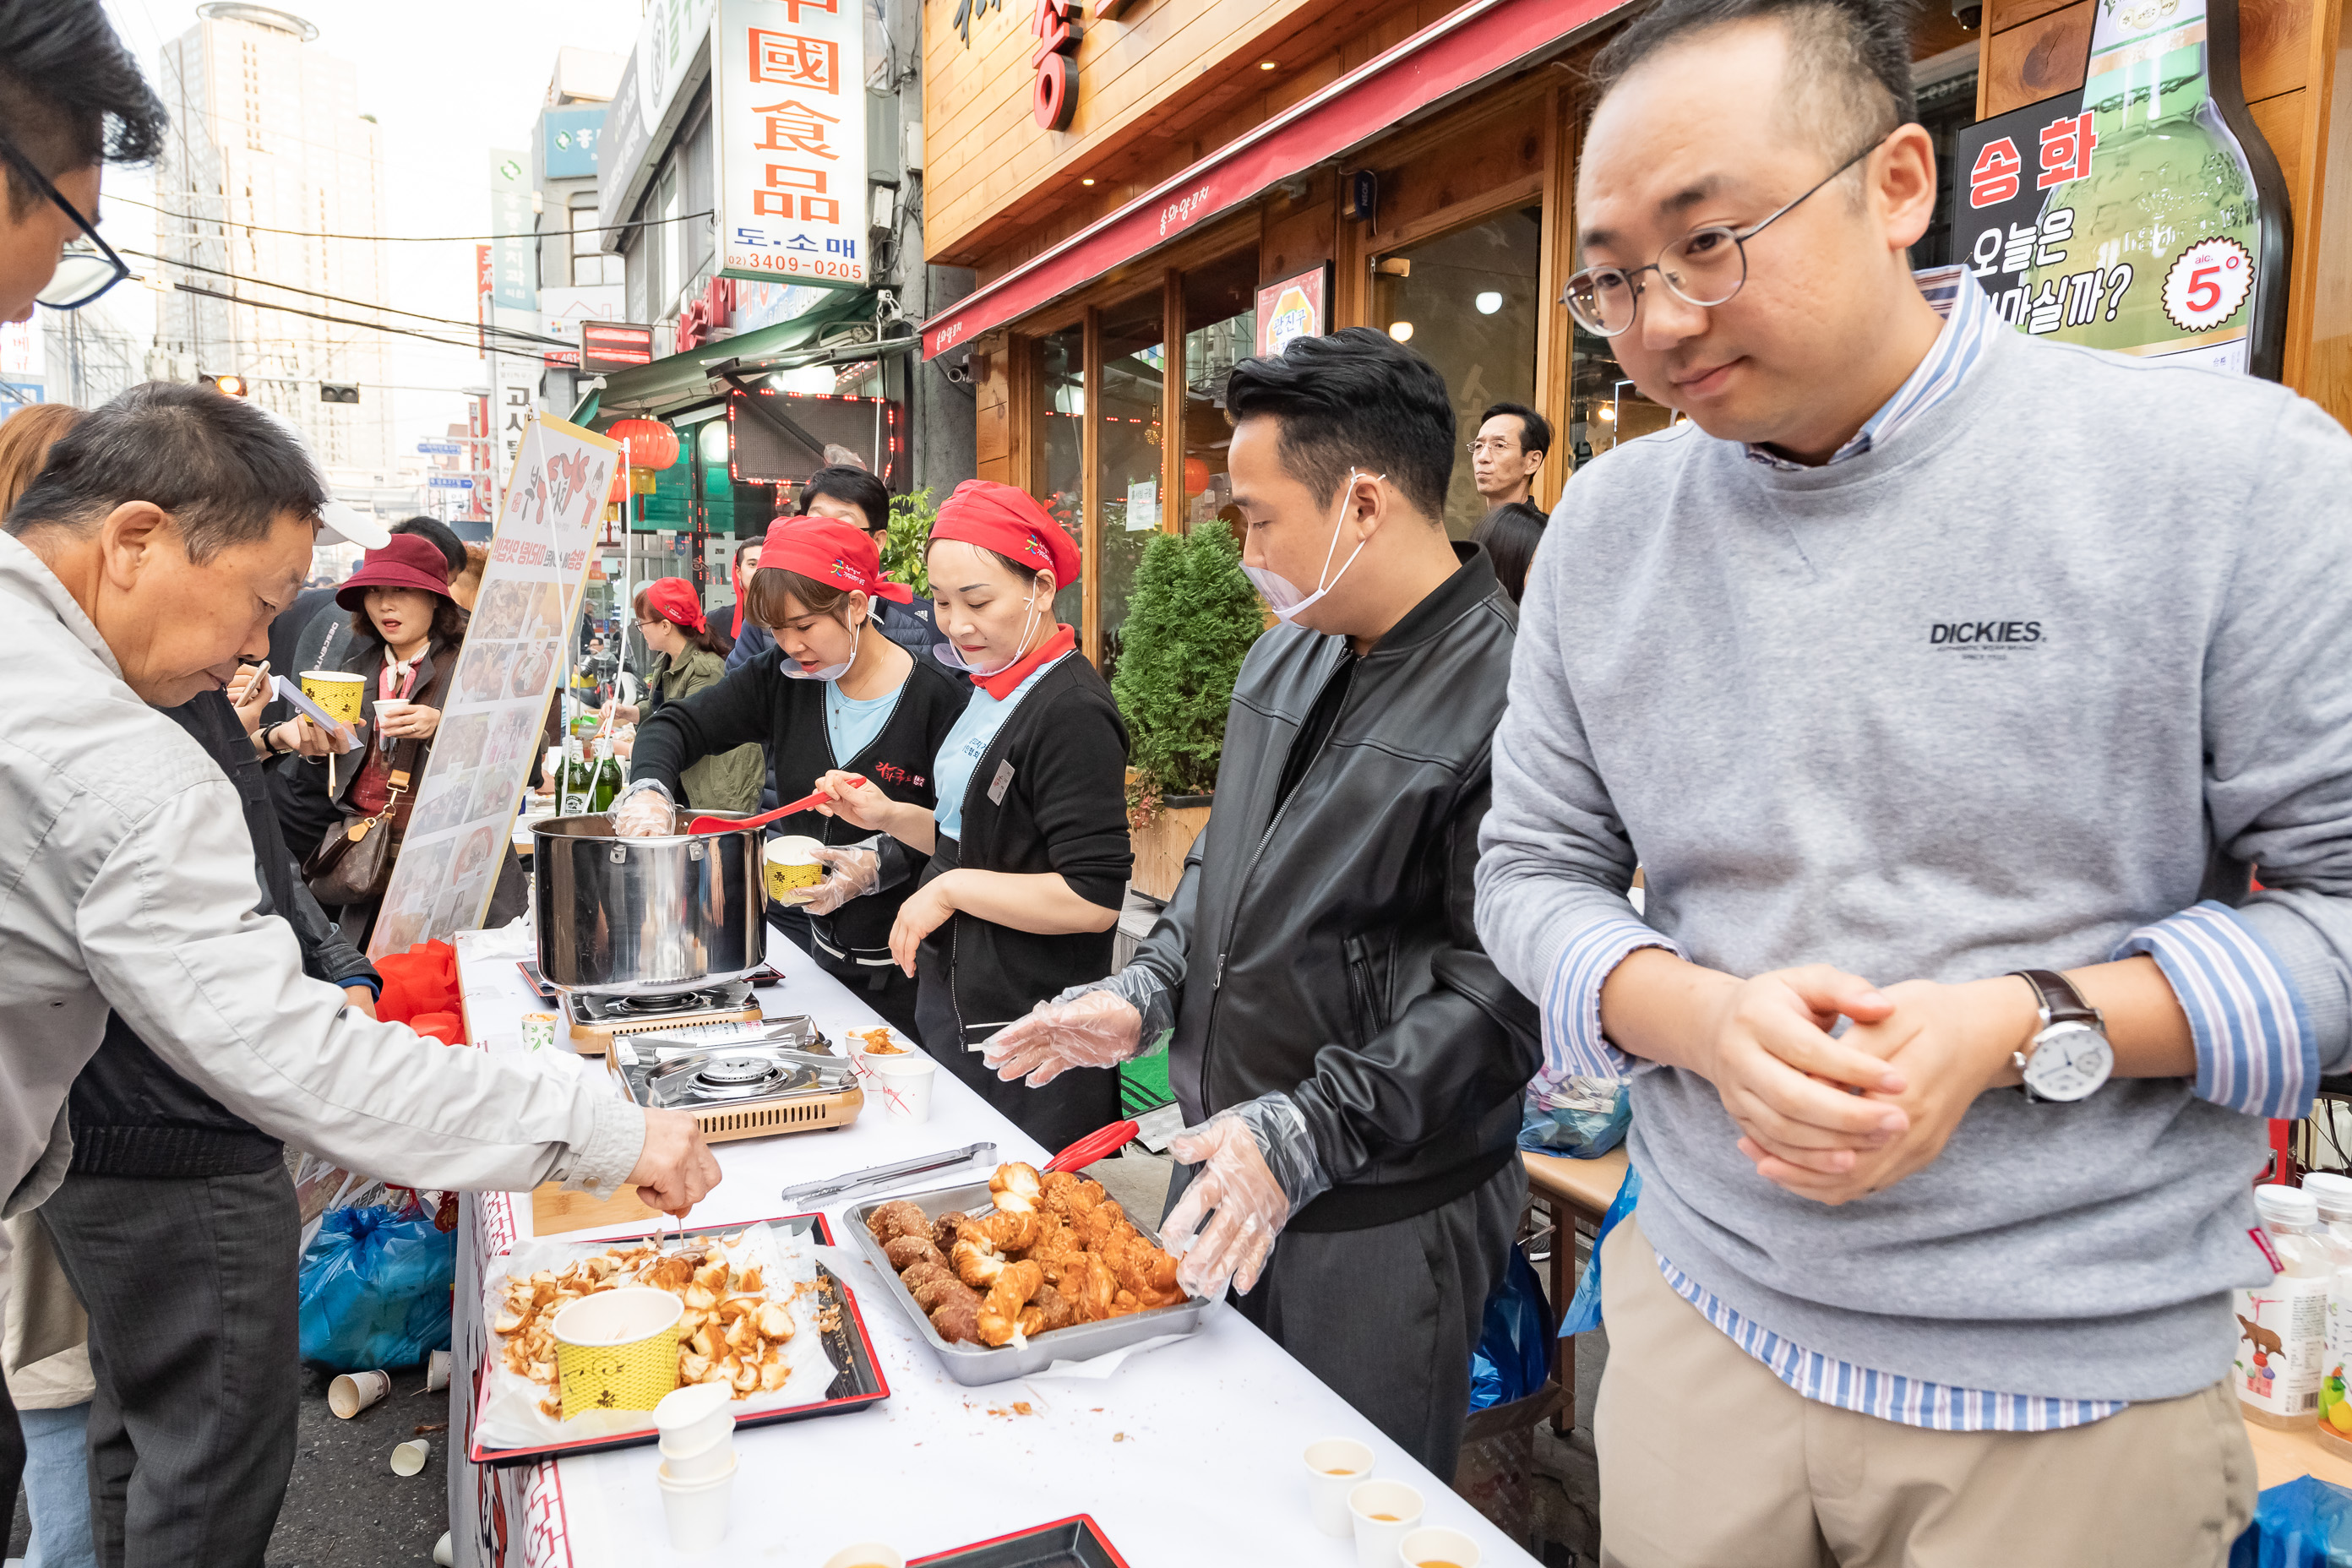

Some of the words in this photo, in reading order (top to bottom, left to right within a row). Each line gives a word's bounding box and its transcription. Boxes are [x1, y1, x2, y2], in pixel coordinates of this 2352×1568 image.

[1971, 208, 2075, 279] 오늘은
[2195, 253, 2213, 264] alc.
[1273, 309, 1307, 337] 광진구
[1990, 264, 2134, 335] 마실까?
